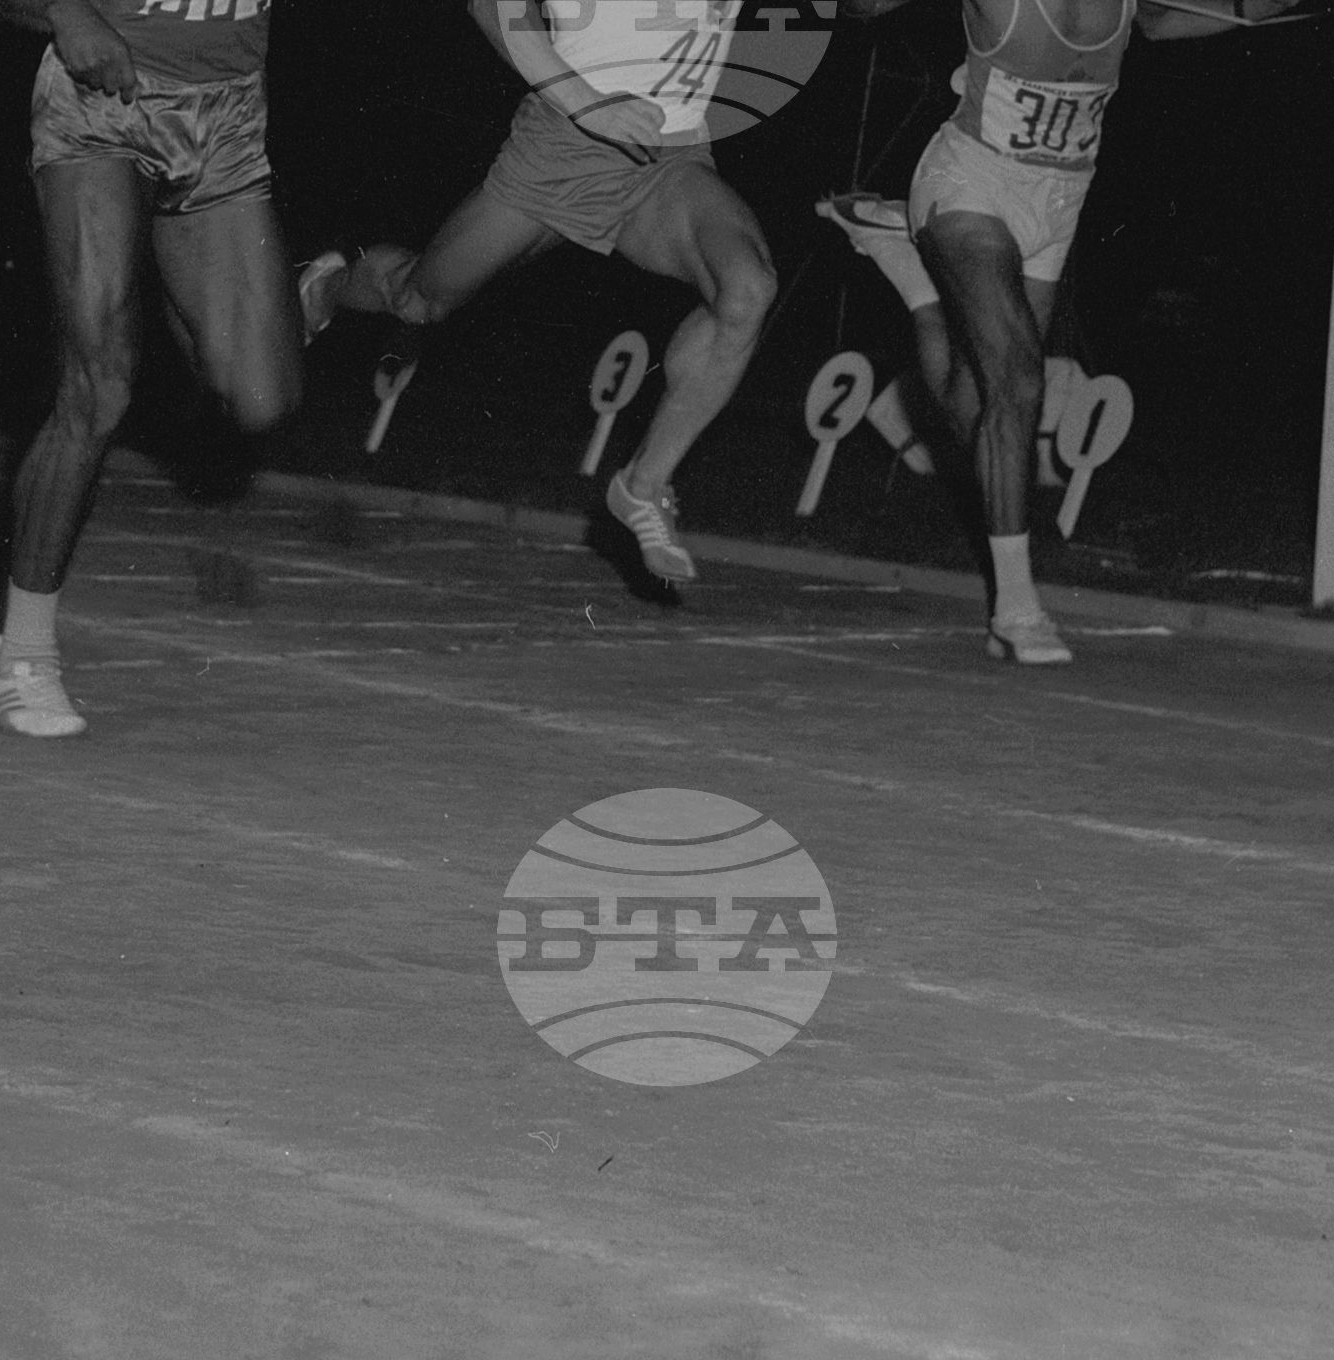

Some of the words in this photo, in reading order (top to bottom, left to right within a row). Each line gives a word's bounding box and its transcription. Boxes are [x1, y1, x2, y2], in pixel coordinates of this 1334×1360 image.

[600, 350, 633, 403] 3
[819, 372, 857, 430] 2
[1078, 397, 1108, 457] 1
